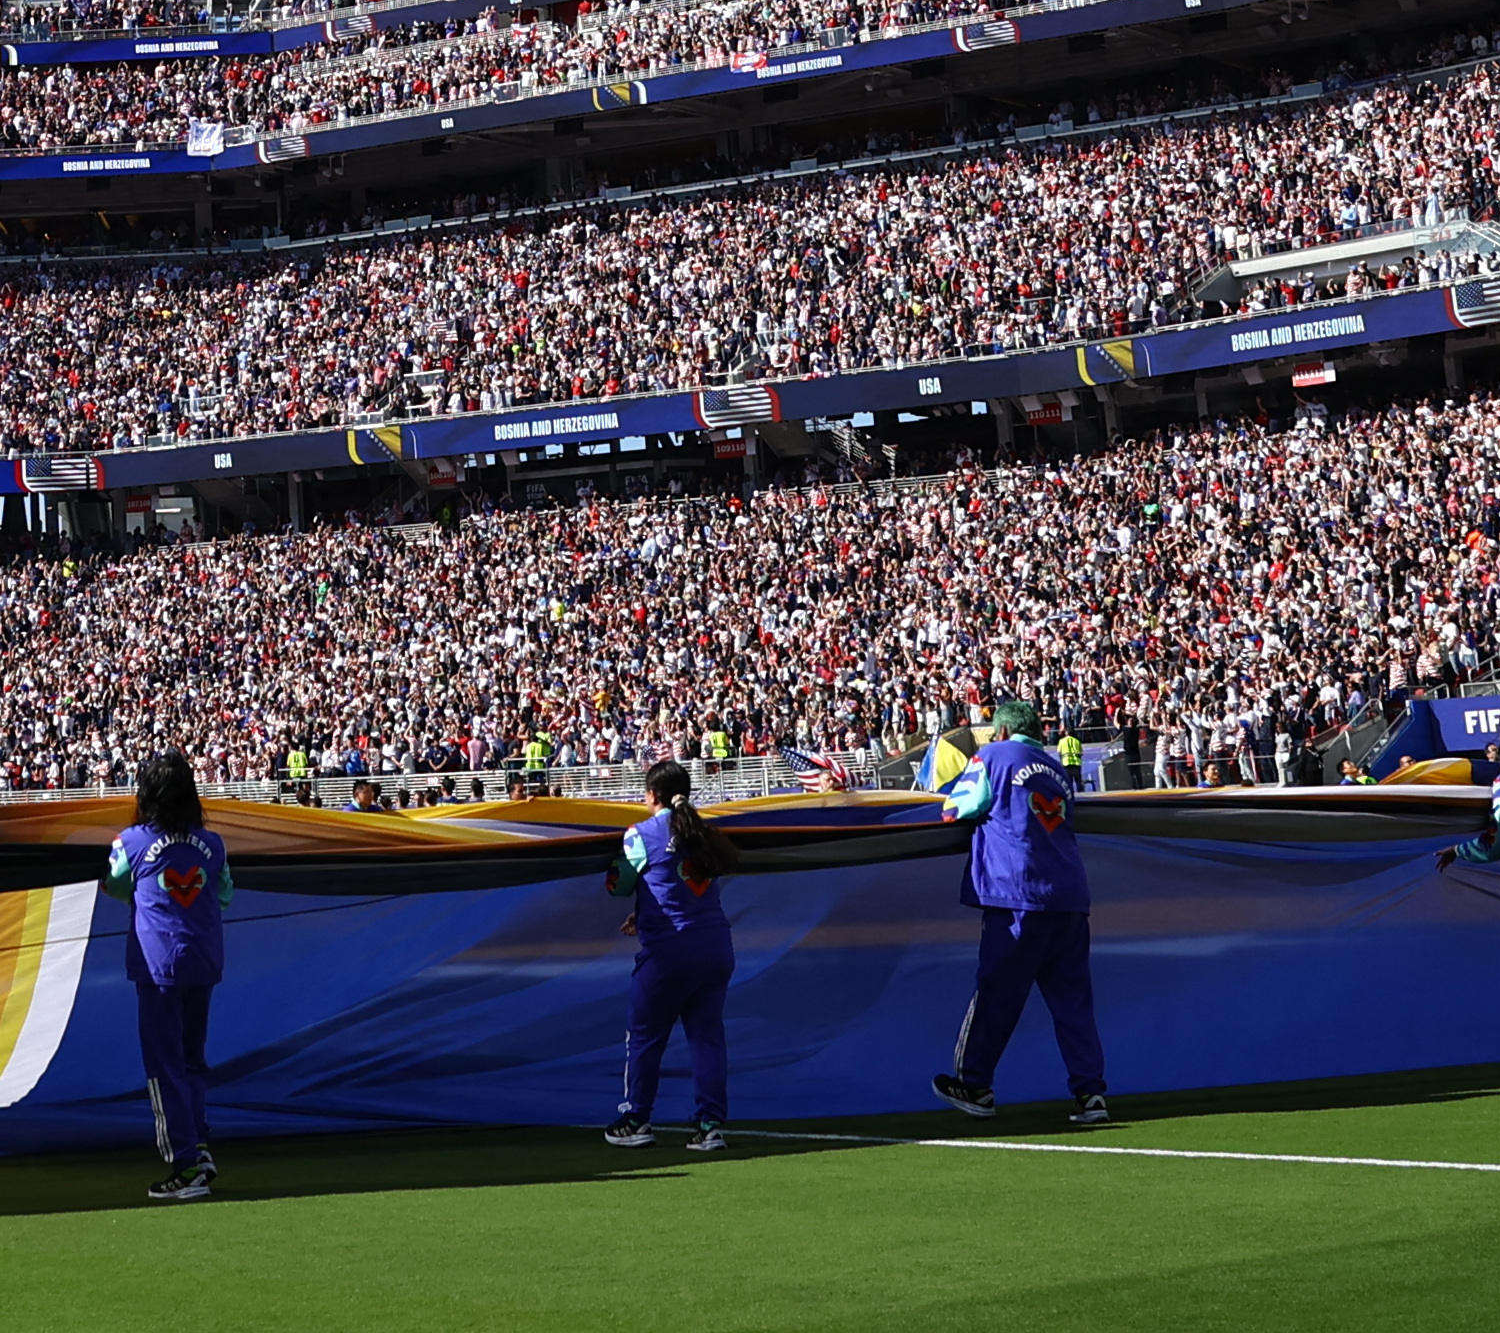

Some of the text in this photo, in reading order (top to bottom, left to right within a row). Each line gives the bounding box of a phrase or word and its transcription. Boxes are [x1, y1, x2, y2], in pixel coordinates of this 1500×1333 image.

[783, 63, 796, 74] AND
[797, 55, 842, 72] HERZEGOVINA
[441, 118, 453, 128] USA
[1231, 315, 1364, 351] BOSNIA AND HERZEGOVINA
[919, 378, 941, 395] USA
[1030, 409, 1060, 419] 110 111
[495, 413, 618, 440] BOSNIA AND HERZEGOVINA
[215, 453, 232, 468] USA
[1464, 710, 1500, 734] FIF
